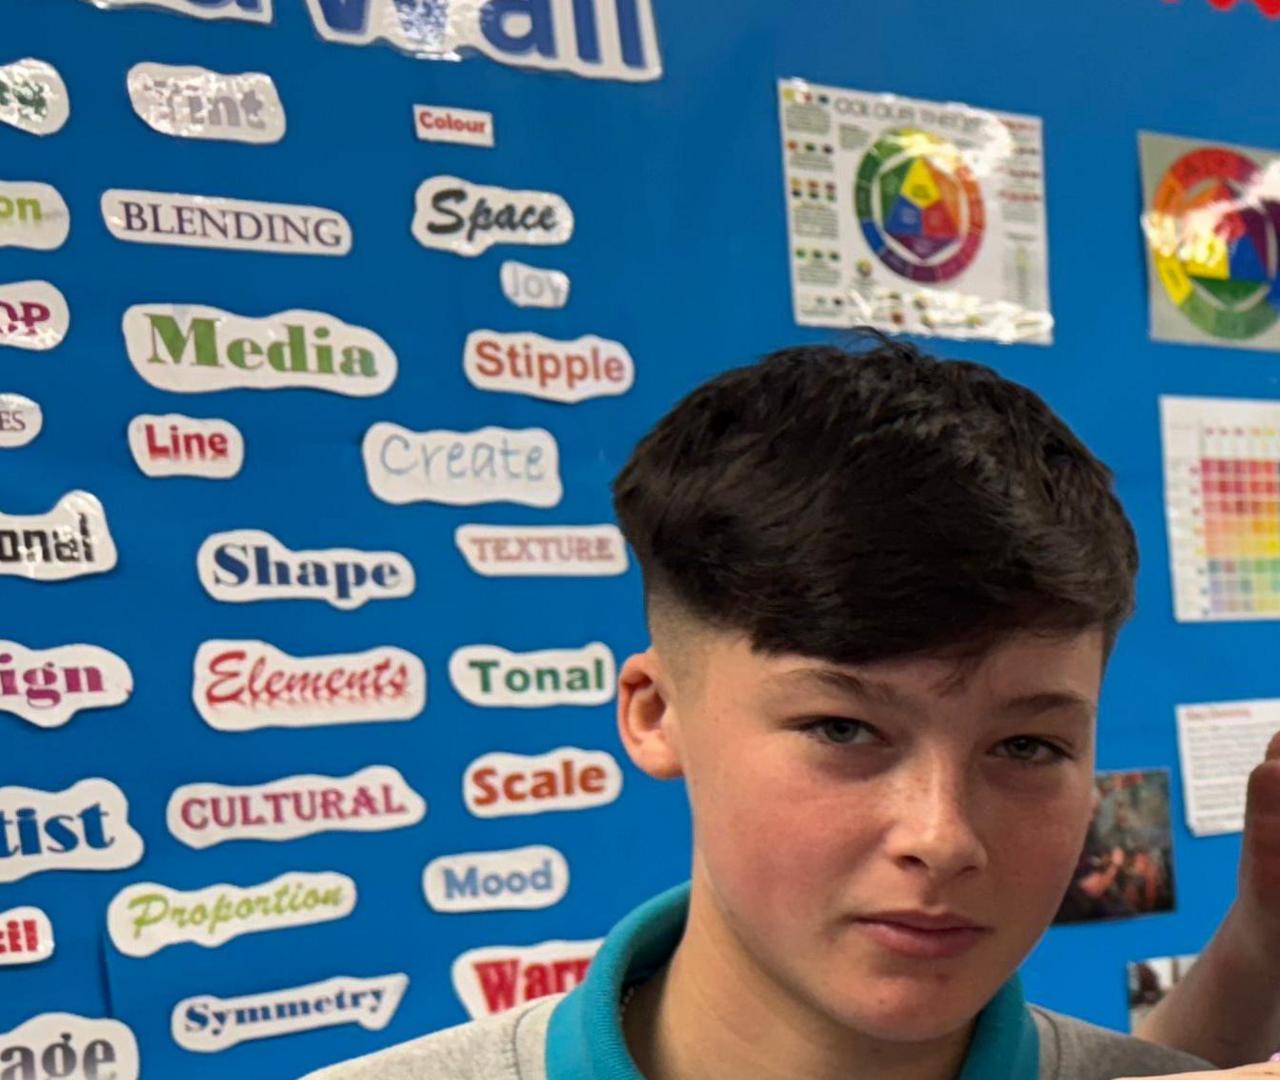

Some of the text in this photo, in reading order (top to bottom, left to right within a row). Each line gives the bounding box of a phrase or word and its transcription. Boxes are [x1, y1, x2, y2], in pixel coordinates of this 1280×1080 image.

[419, 111, 486, 134] Colour
[120, 200, 343, 247] BLENDING
[426, 188, 560, 242] Space
[143, 313, 379, 378] Media
[475, 340, 624, 389] Stipple
[145, 424, 229, 460] Line
[380, 434, 545, 482] Create
[213, 542, 401, 599] Shape
[469, 535, 615, 563] TEXTURE
[205, 651, 408, 703] Elements
[468, 657, 604, 696] Tonal
[472, 759, 606, 806] Scale
[180, 784, 407, 831] CULTURAL
[442, 858, 554, 900] Mood
[128, 881, 343, 940] Proportion
[184, 986, 386, 1036] Symmetry
